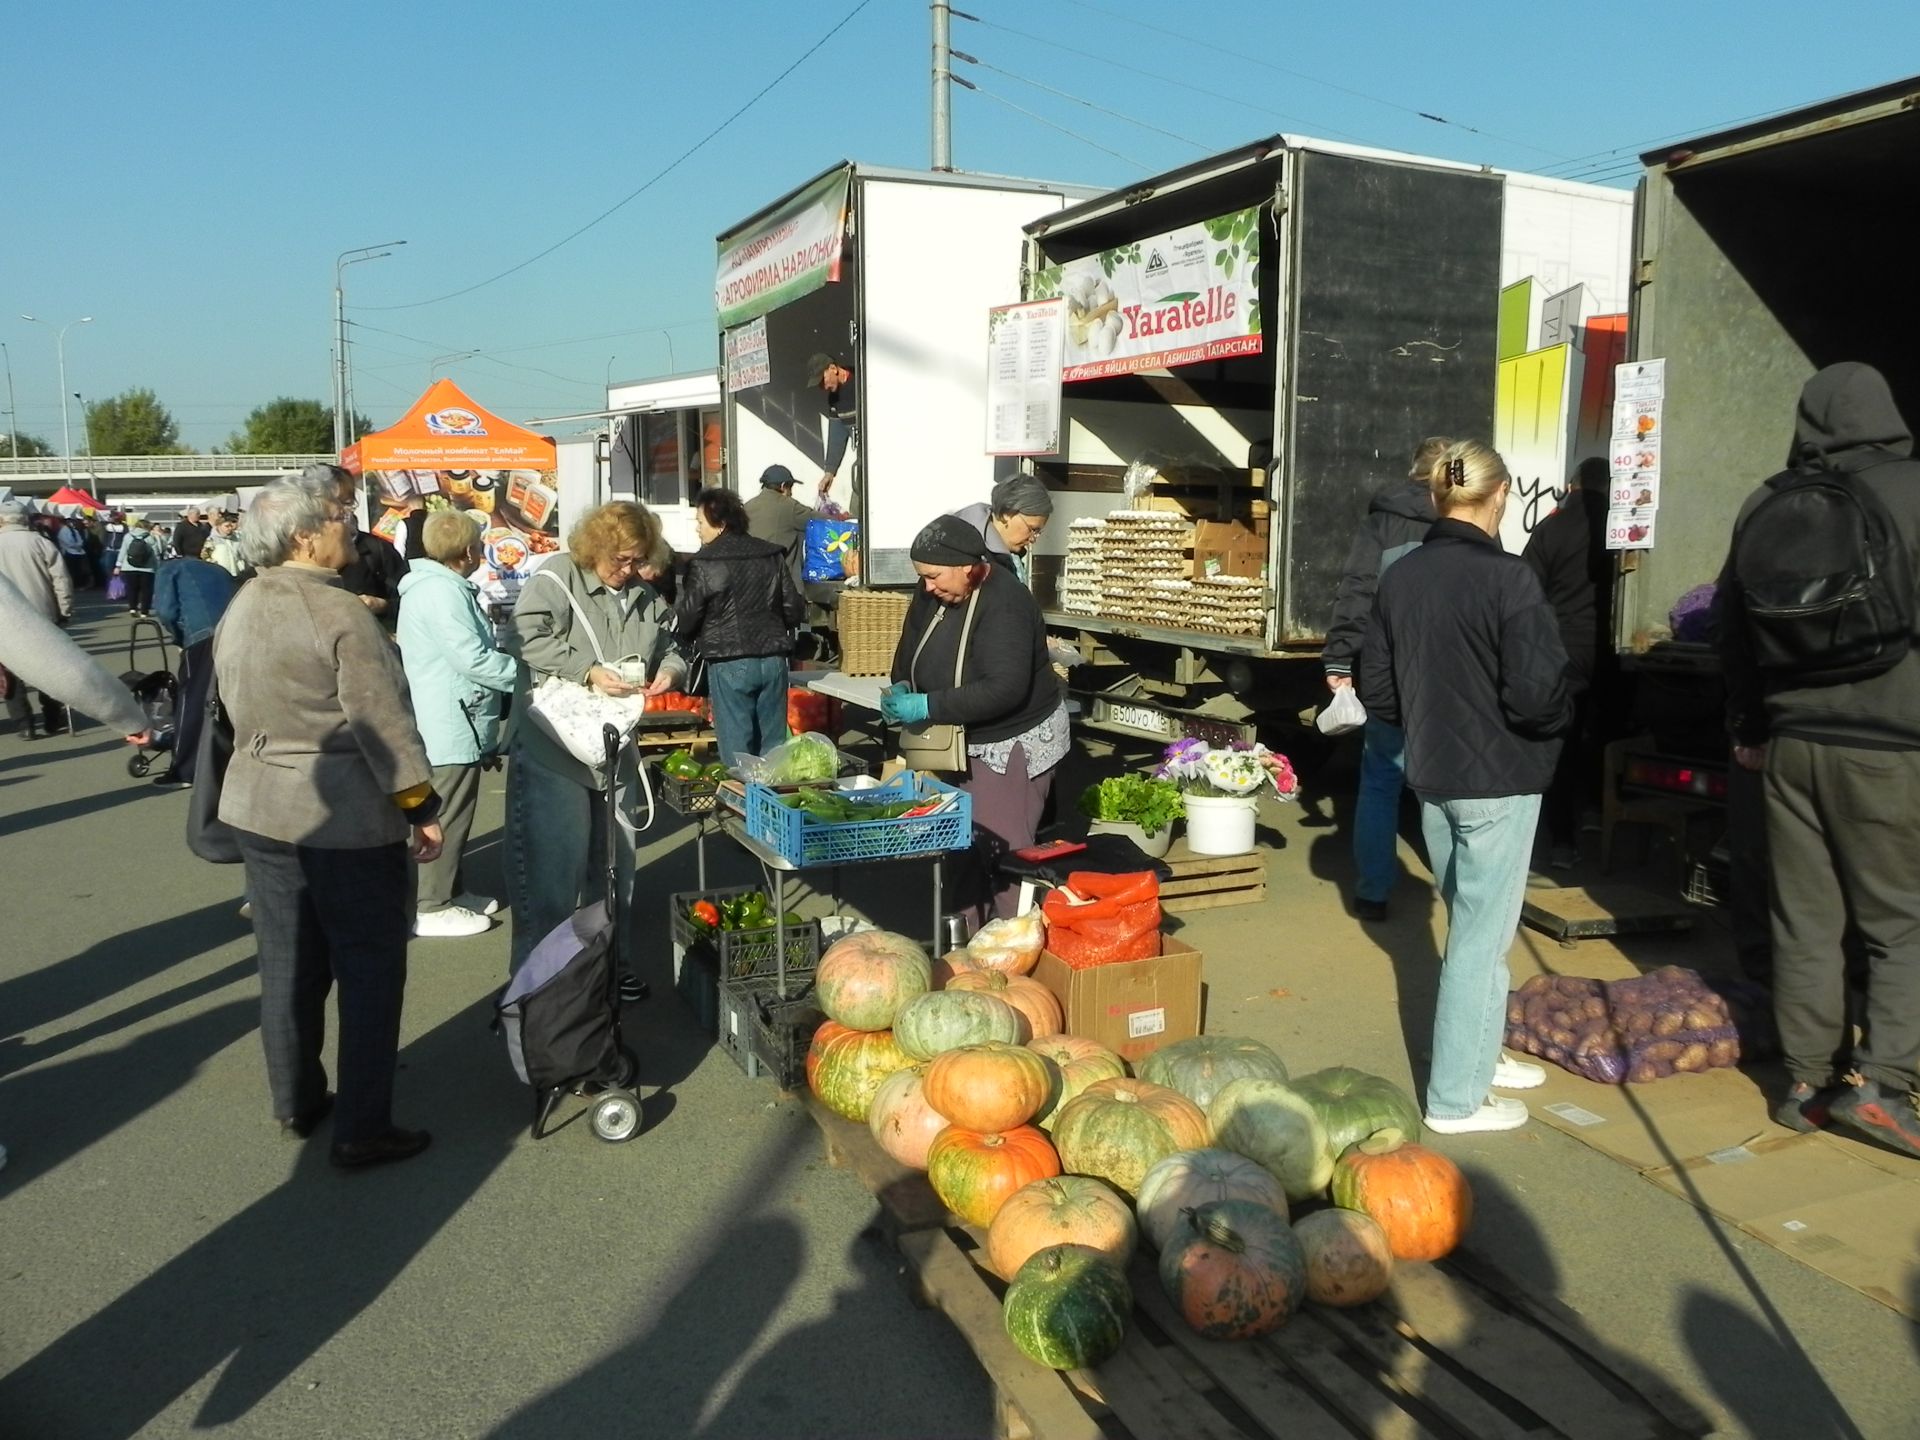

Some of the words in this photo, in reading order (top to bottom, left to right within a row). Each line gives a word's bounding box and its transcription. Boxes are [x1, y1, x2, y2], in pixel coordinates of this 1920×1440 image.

[1123, 284, 1236, 340] Yaratelle
[1104, 359, 1127, 374] ЯЙЦА
[1128, 358, 1139, 371] ИЗ
[1140, 354, 1161, 369] СЕЛА
[393, 447, 443, 455] Молочный
[445, 446, 489, 455] комбинат
[1614, 455, 1632, 466] 40
[1614, 489, 1631, 501] 30
[1610, 528, 1627, 540] 30
